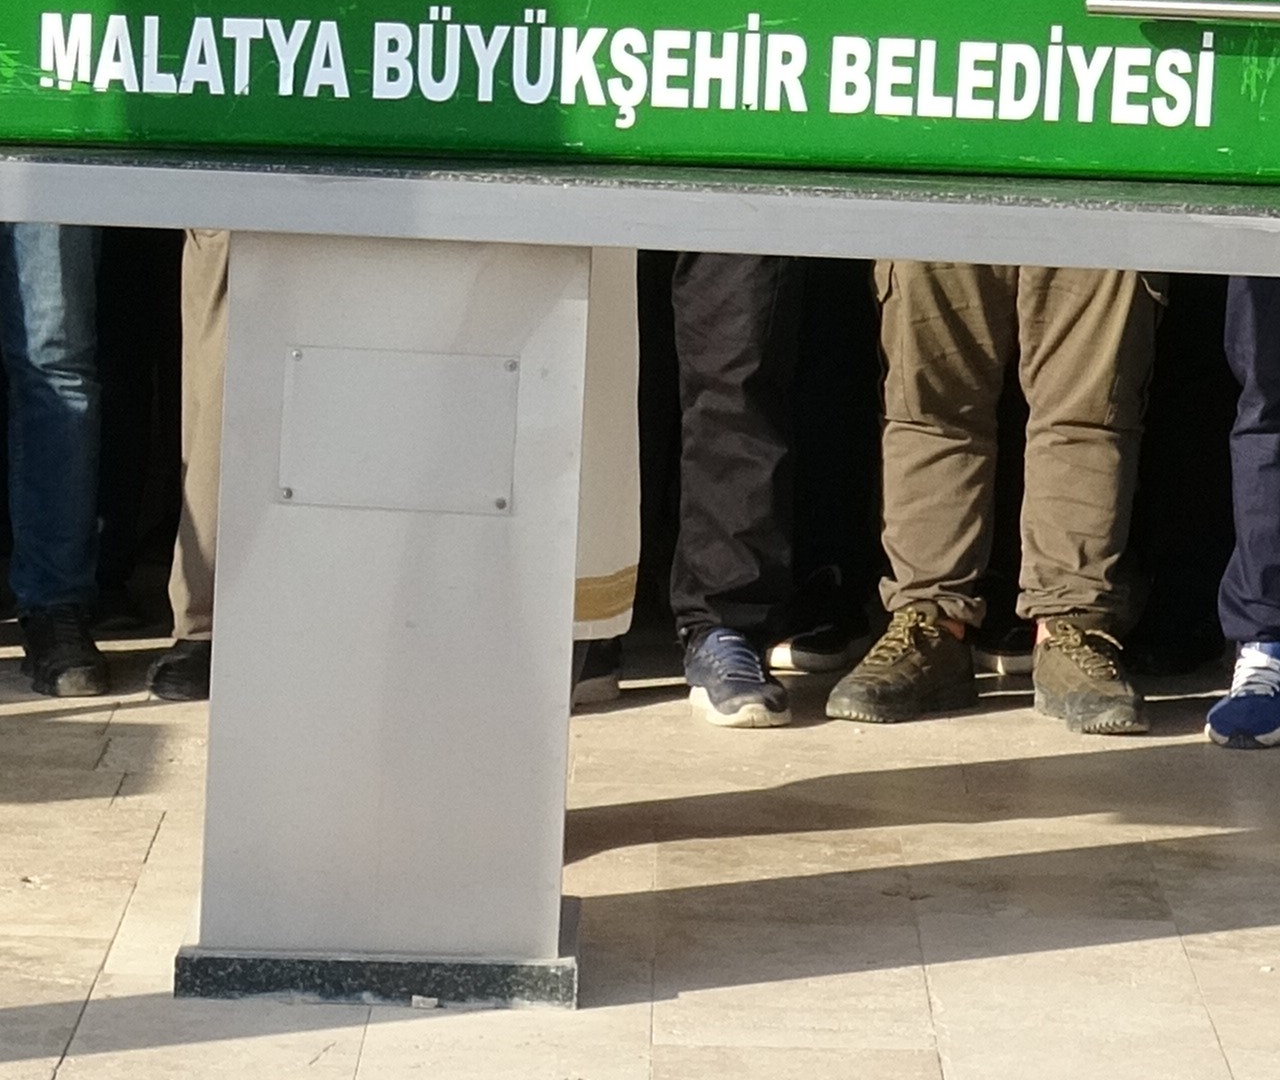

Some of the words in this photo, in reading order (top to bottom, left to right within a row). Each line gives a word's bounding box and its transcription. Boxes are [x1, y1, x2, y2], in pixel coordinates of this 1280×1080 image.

[40, 12, 350, 98] MALATYA
[372, 5, 808, 129] BÜYÜKŞEHİR
[828, 24, 1215, 128] BELEDİYESİ
